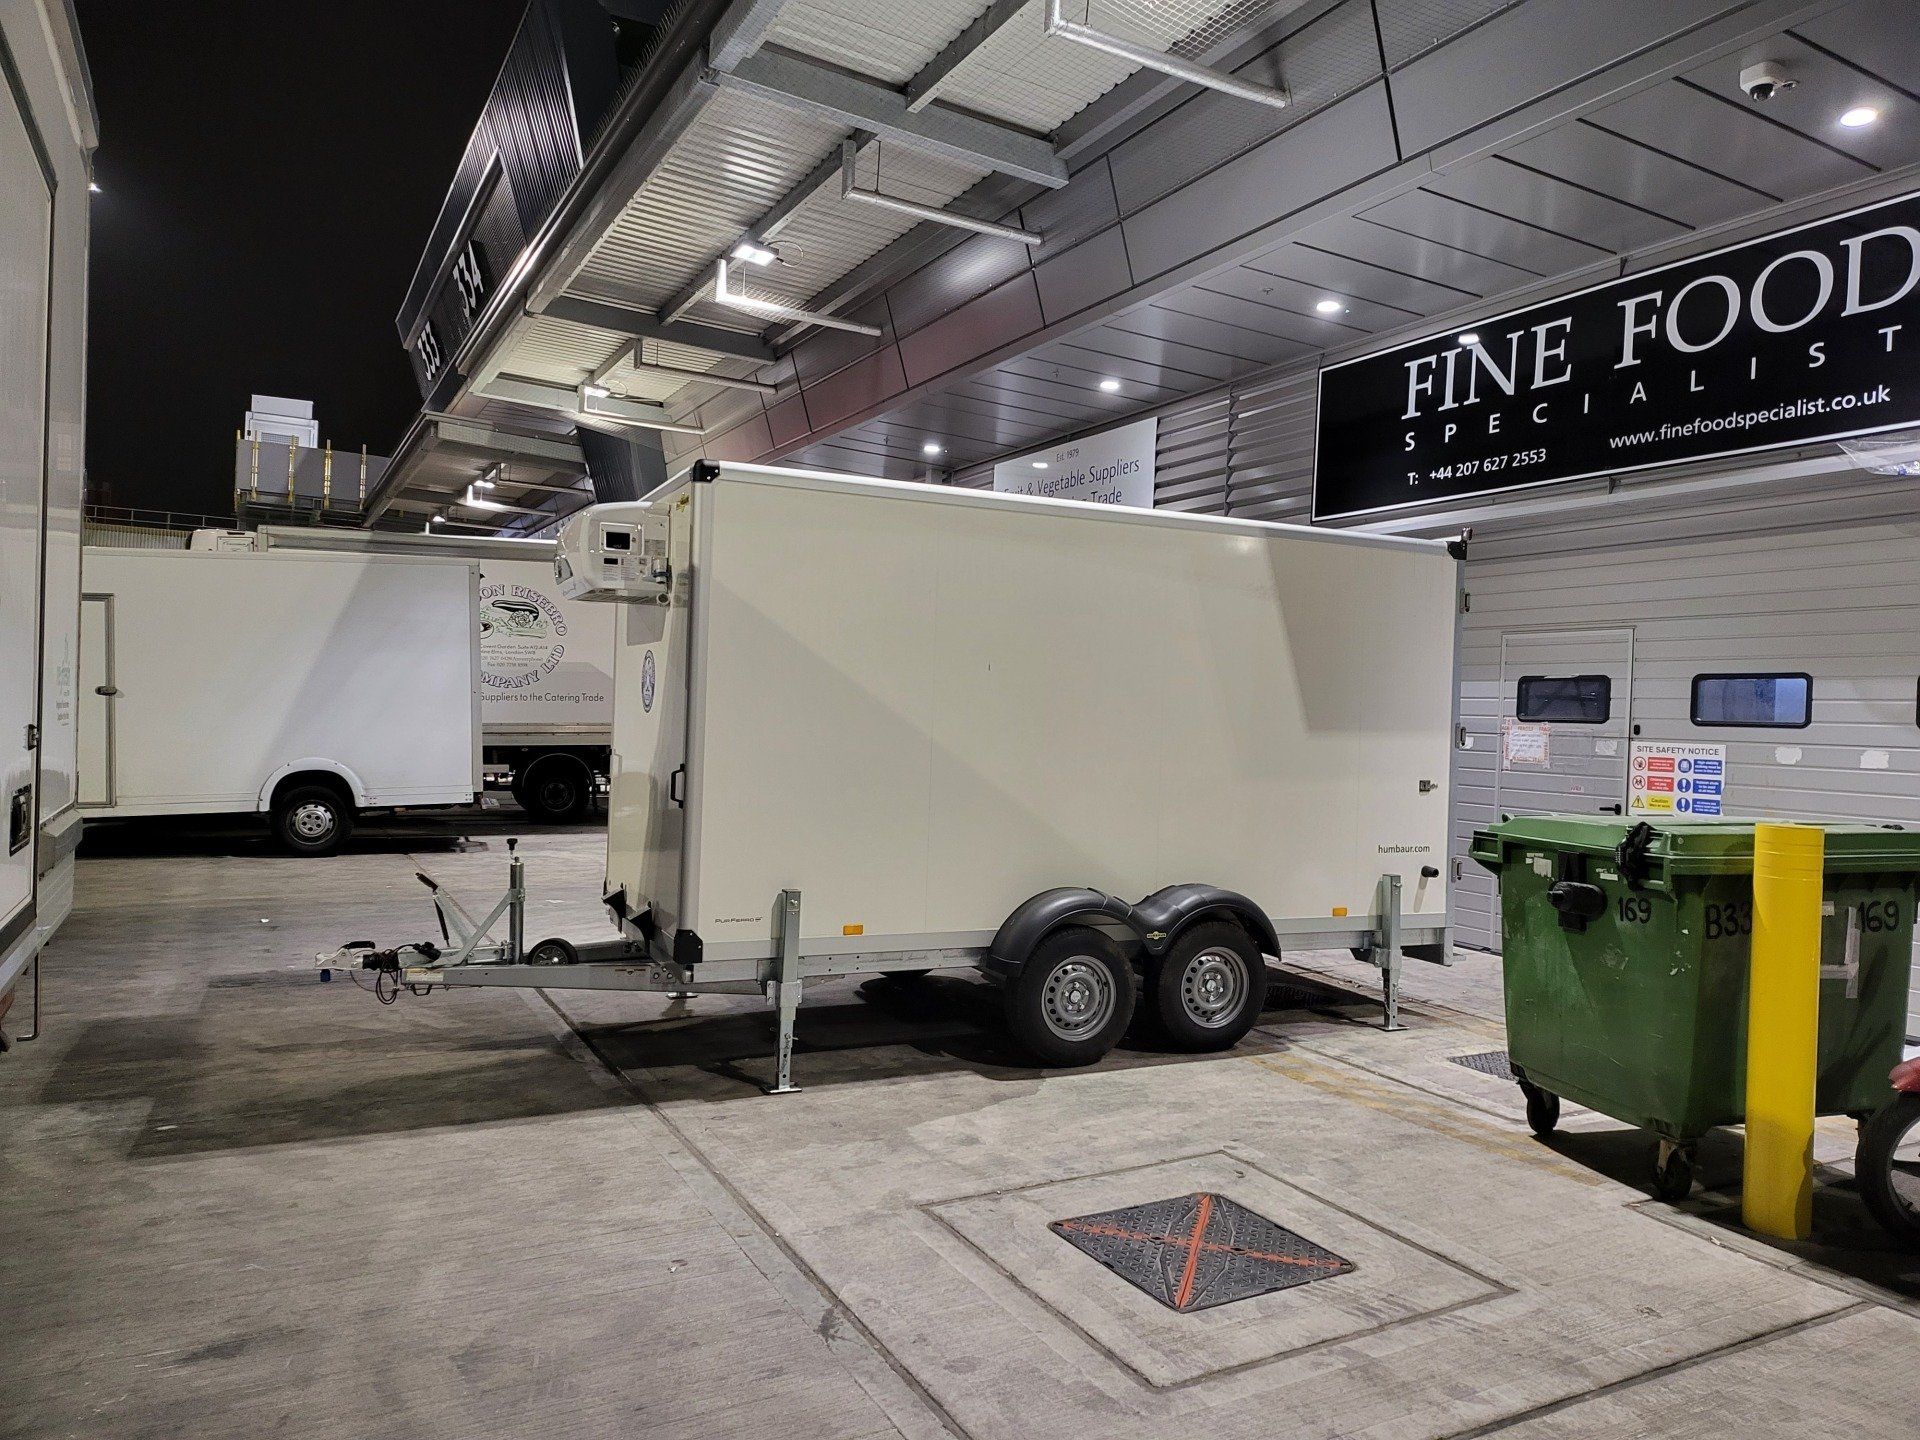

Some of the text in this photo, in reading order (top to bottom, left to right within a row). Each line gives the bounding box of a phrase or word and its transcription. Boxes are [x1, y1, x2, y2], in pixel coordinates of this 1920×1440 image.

[1401, 226, 1920, 420] FINE FOOD
[1405, 325, 1902, 451] SPECIALIST
[1609, 384, 1891, 449] www.finefoodspecialist.co.uk
[1037, 470, 1086, 497] Vegetable
[1088, 459, 1140, 485] Suppliers
[1407, 448, 1547, 486] T: +44 207 627 2553
[1091, 487, 1122, 504] Trade
[480, 584, 567, 636] ON RISEBRO
[480, 644, 565, 688] MPANY LTD
[520, 693, 528, 702] to
[530, 692, 543, 702] the
[544, 692, 580, 703] Catering
[581, 693, 604, 702] Trade
[1637, 745, 1720, 756] SITE SAFETY NOTICE
[1378, 845, 1430, 853] humbaur.com
[1618, 897, 1652, 924] 169
[1858, 900, 1900, 934] 169
